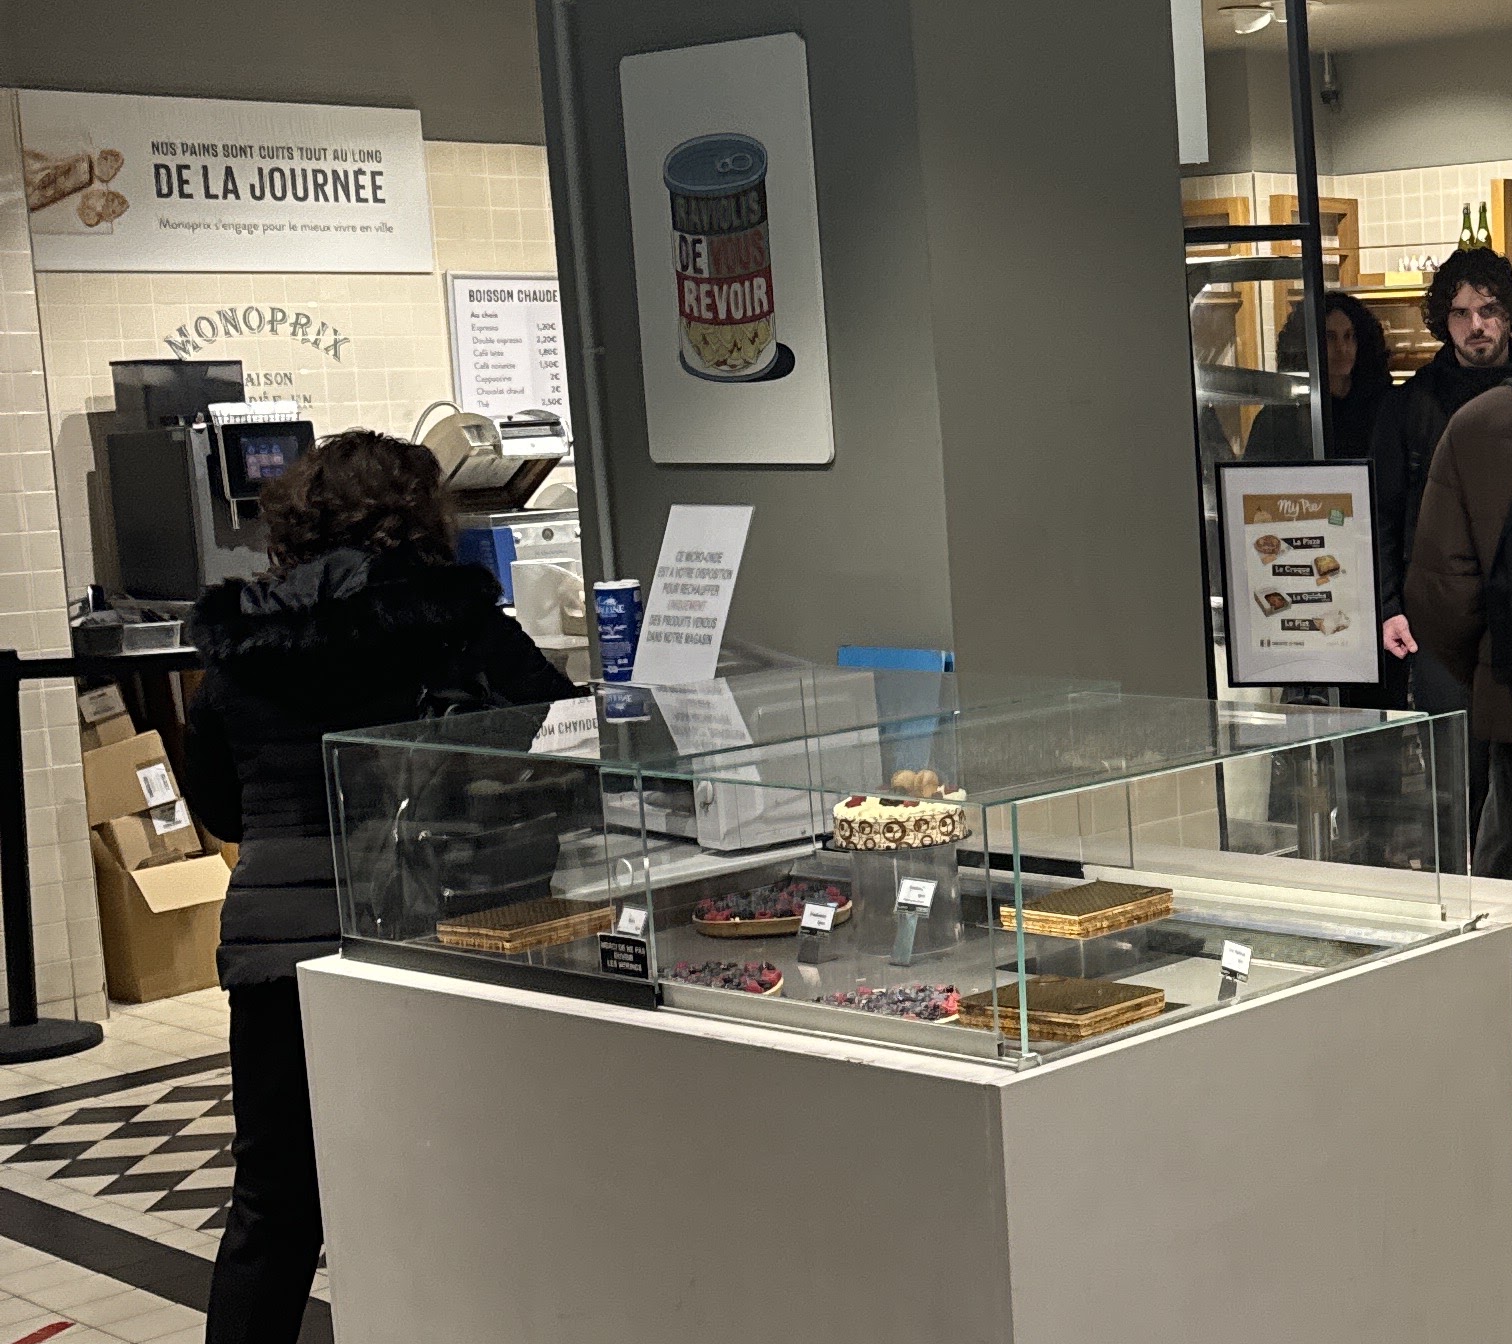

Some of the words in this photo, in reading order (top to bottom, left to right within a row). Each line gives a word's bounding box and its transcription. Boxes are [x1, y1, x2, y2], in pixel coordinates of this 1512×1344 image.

[151, 140, 177, 157] NOS
[180, 141, 218, 158] PAINS
[222, 143, 254, 159] SONT
[258, 144, 294, 161] CUITS
[297, 146, 328, 162] TOUT
[332, 147, 348, 163] AU
[351, 148, 382, 164] LONG
[153, 163, 194, 200] DE
[201, 164, 241, 201] LA
[249, 166, 386, 204] JOURNÉE
[158, 217, 211, 234] Monoprix
[262, 221, 286, 235] pour
[288, 221, 298, 232] le
[300, 222, 331, 233] mieux
[333, 223, 357, 233] vivre
[360, 224, 373, 234] en
[375, 221, 394, 234] ville
[678, 234, 704, 275] DE
[468, 289, 514, 303] BOISSON
[517, 289, 558, 303] CHAUDE
[683, 276, 769, 320] REVOIR
[164, 306, 351, 364] MONOPRIX
[244, 372, 293, 387] AISON
